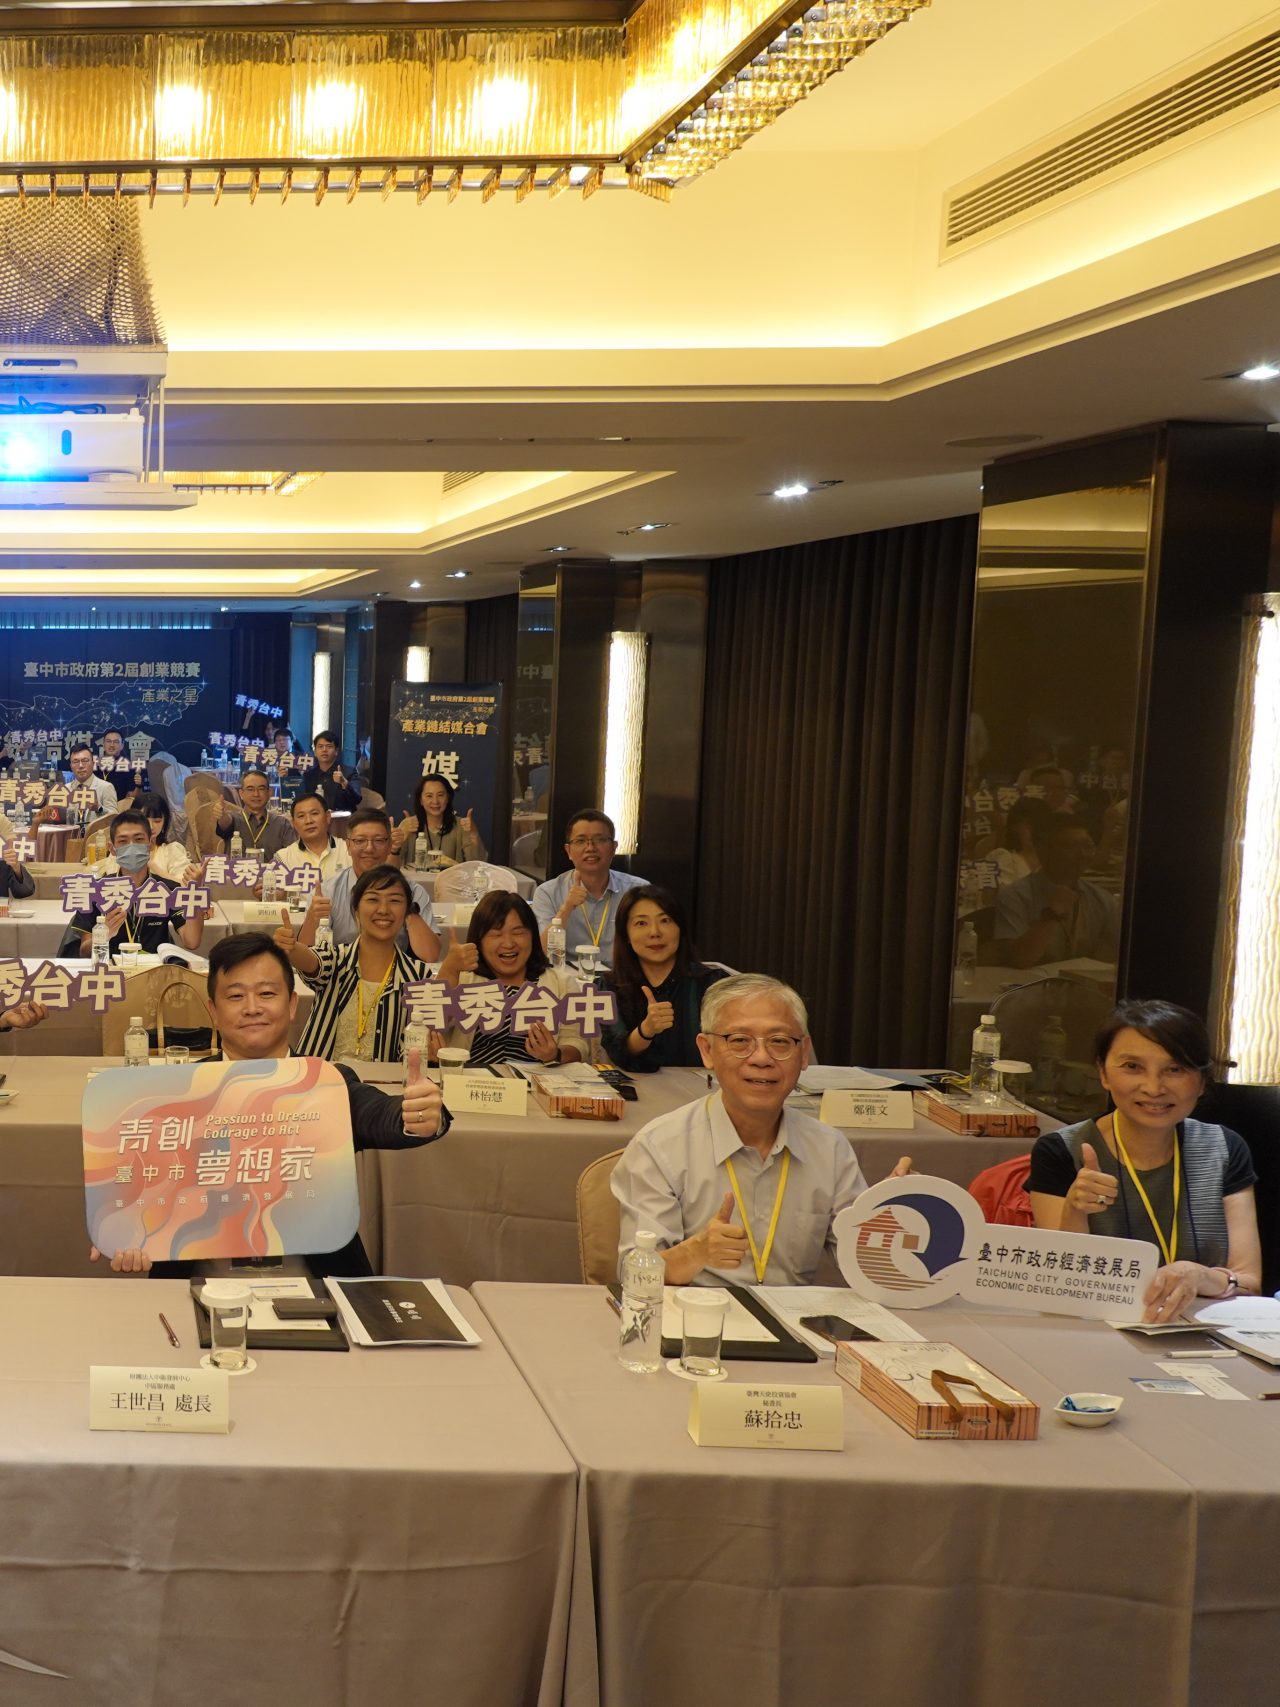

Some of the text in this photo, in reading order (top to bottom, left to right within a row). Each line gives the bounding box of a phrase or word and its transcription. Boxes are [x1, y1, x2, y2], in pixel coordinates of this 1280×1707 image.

[24, 662, 200, 678] 臺中市政府第2屆創業競賽
[141, 688, 198, 704] 產業之星
[235, 694, 283, 718] 青秀台中
[10, 729, 62, 743] 青秀台中
[401, 719, 488, 735] 產業鏈結媒合會
[243, 746, 314, 770] 青秀台中
[205, 857, 321, 893] 青秀台中
[62, 877, 209, 918] 青秀台中
[405, 982, 614, 1035] 青秀台中
[469, 1089, 503, 1103] 林怡慧
[205, 1111, 320, 1126] Passion to Dream
[118, 1115, 194, 1154] 青創
[203, 1124, 301, 1140] Courage to Act
[115, 1146, 316, 1186] 臺中市 夢想家
[977, 1242, 1141, 1280] 臺中市政府經濟發展局
[976, 1278, 1134, 1305] ECONOMIC DEVELOPMENT BUREAU
[978, 1267, 1136, 1294] TAICHUNG CITY GOVERNMENT
[109, 1392, 212, 1413] 王世昌 處長
[744, 1409, 803, 1430] 蘇拾忠
